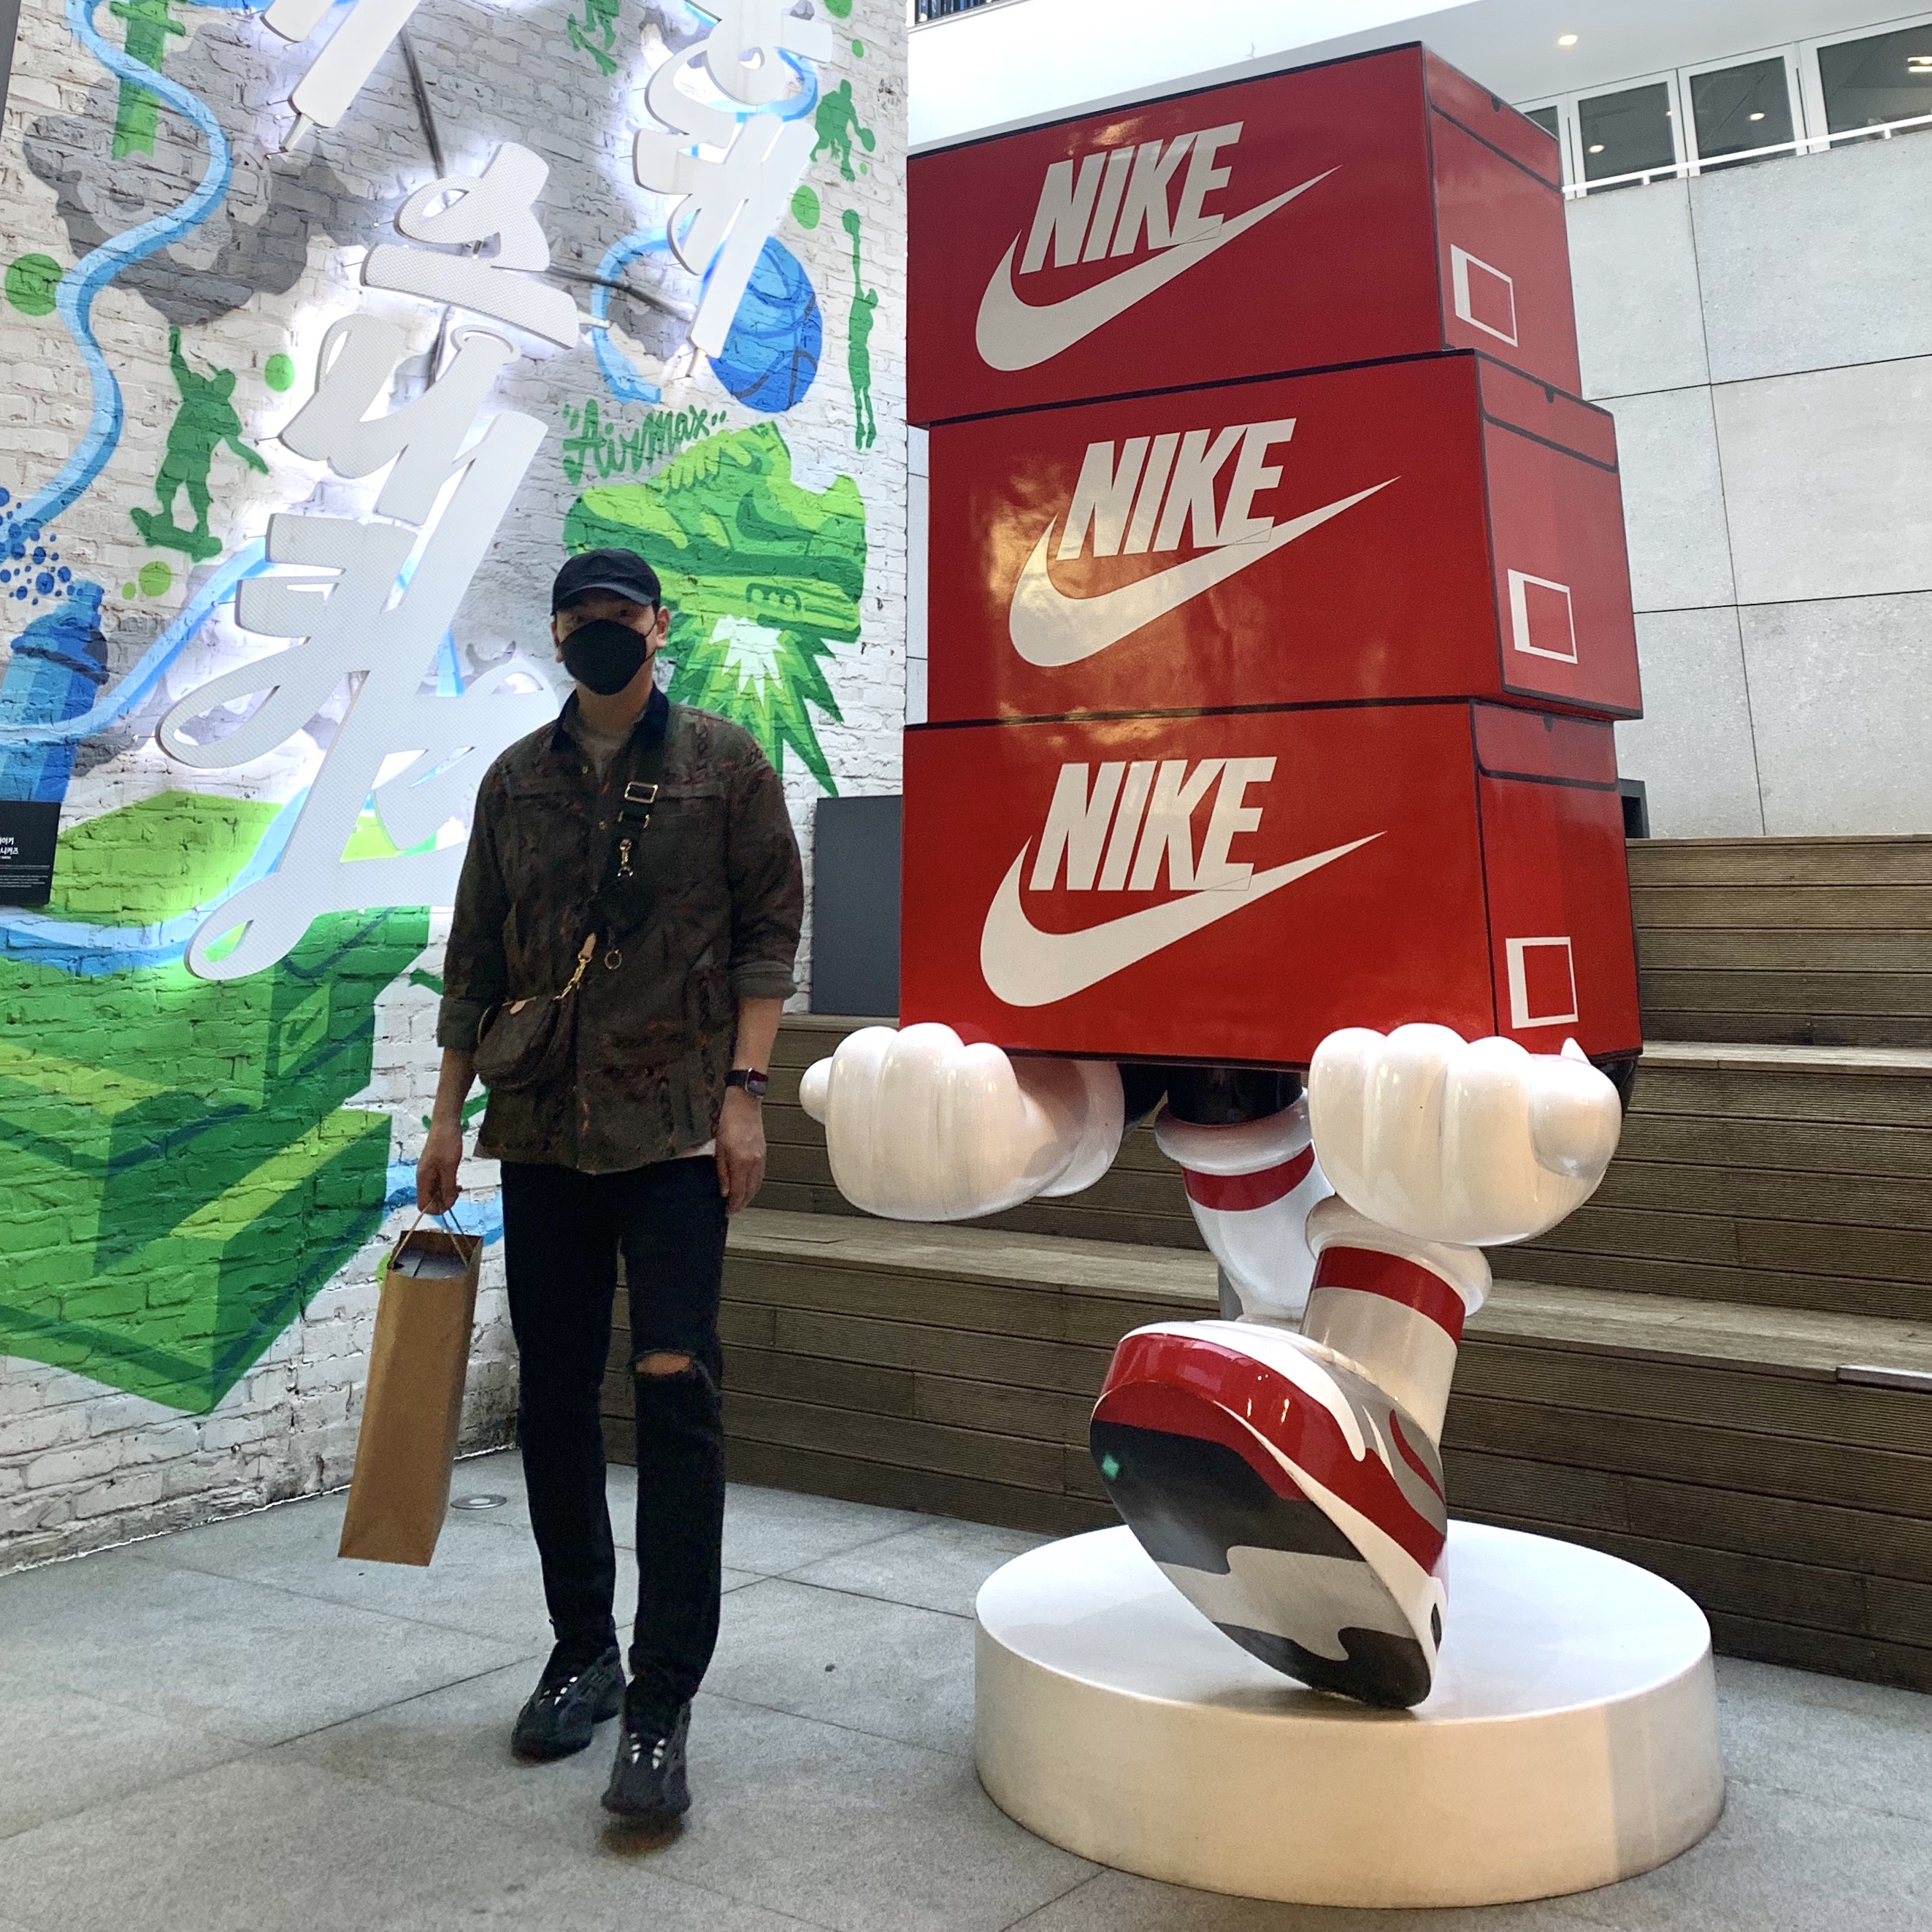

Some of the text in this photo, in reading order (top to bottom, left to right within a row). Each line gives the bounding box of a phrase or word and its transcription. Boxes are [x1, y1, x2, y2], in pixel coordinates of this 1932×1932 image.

[1019, 121, 1244, 275] NIKE
[1055, 417, 1297, 561] NIKE
[1030, 756, 1277, 892] NIKE
